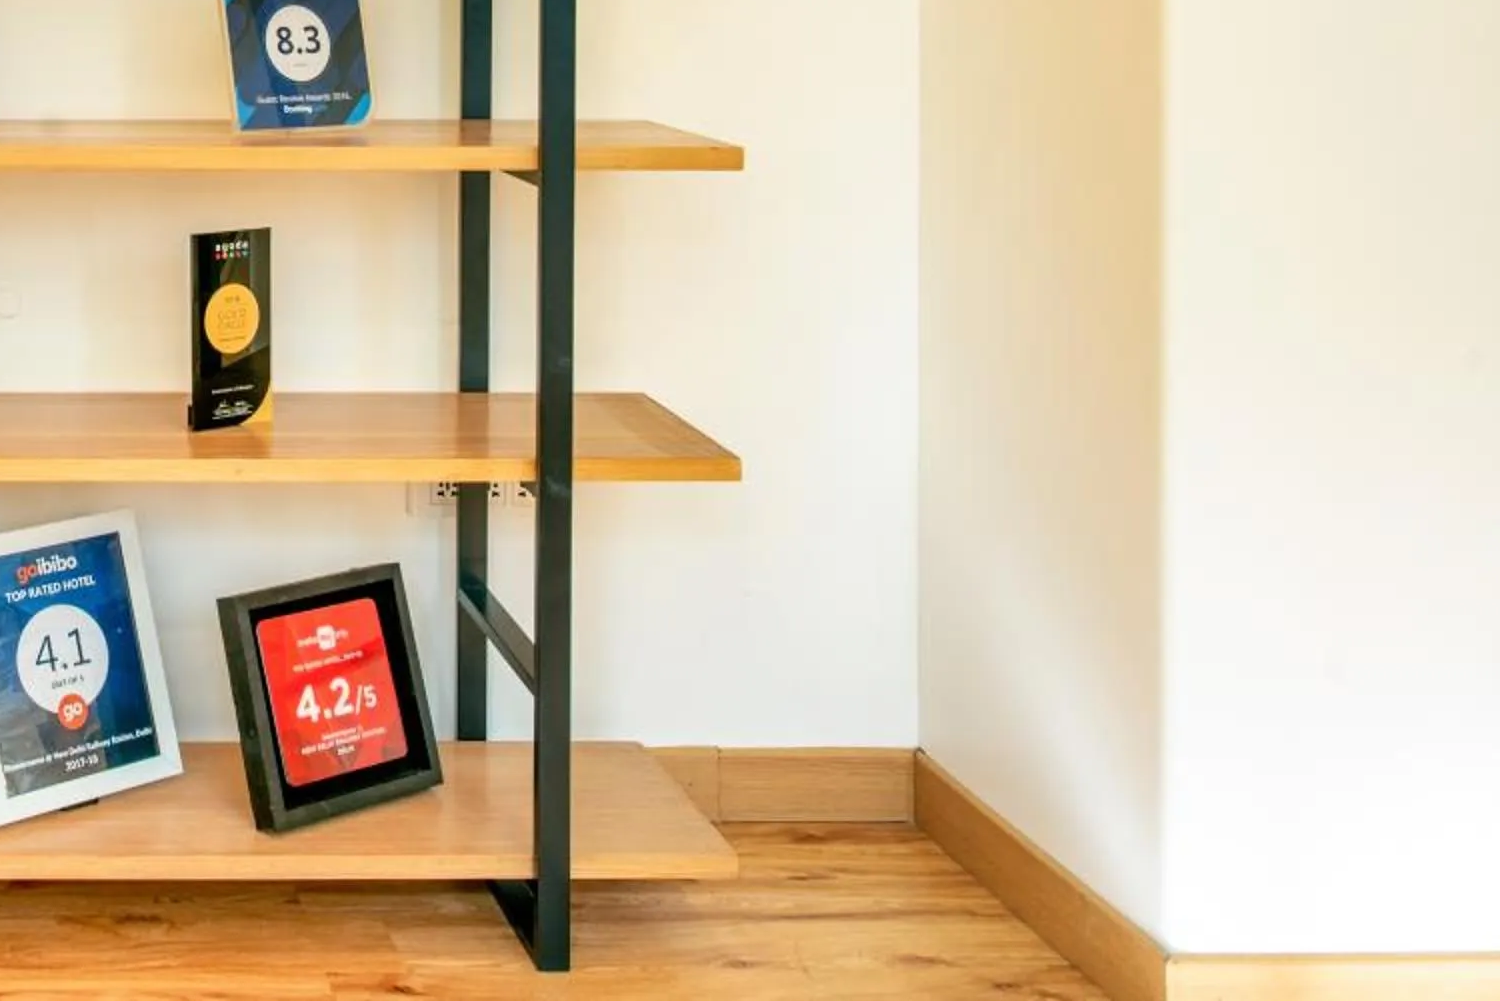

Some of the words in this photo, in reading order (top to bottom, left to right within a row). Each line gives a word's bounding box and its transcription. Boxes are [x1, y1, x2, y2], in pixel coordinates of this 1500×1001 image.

[276, 25, 322, 56] 8.3
[16, 554, 78, 586] goibibo
[5, 589, 27, 604] TOP
[28, 582, 61, 599] RATED
[62, 575, 96, 592] HOTEL
[36, 627, 92, 672] 4.1
[63, 701, 83, 722] go
